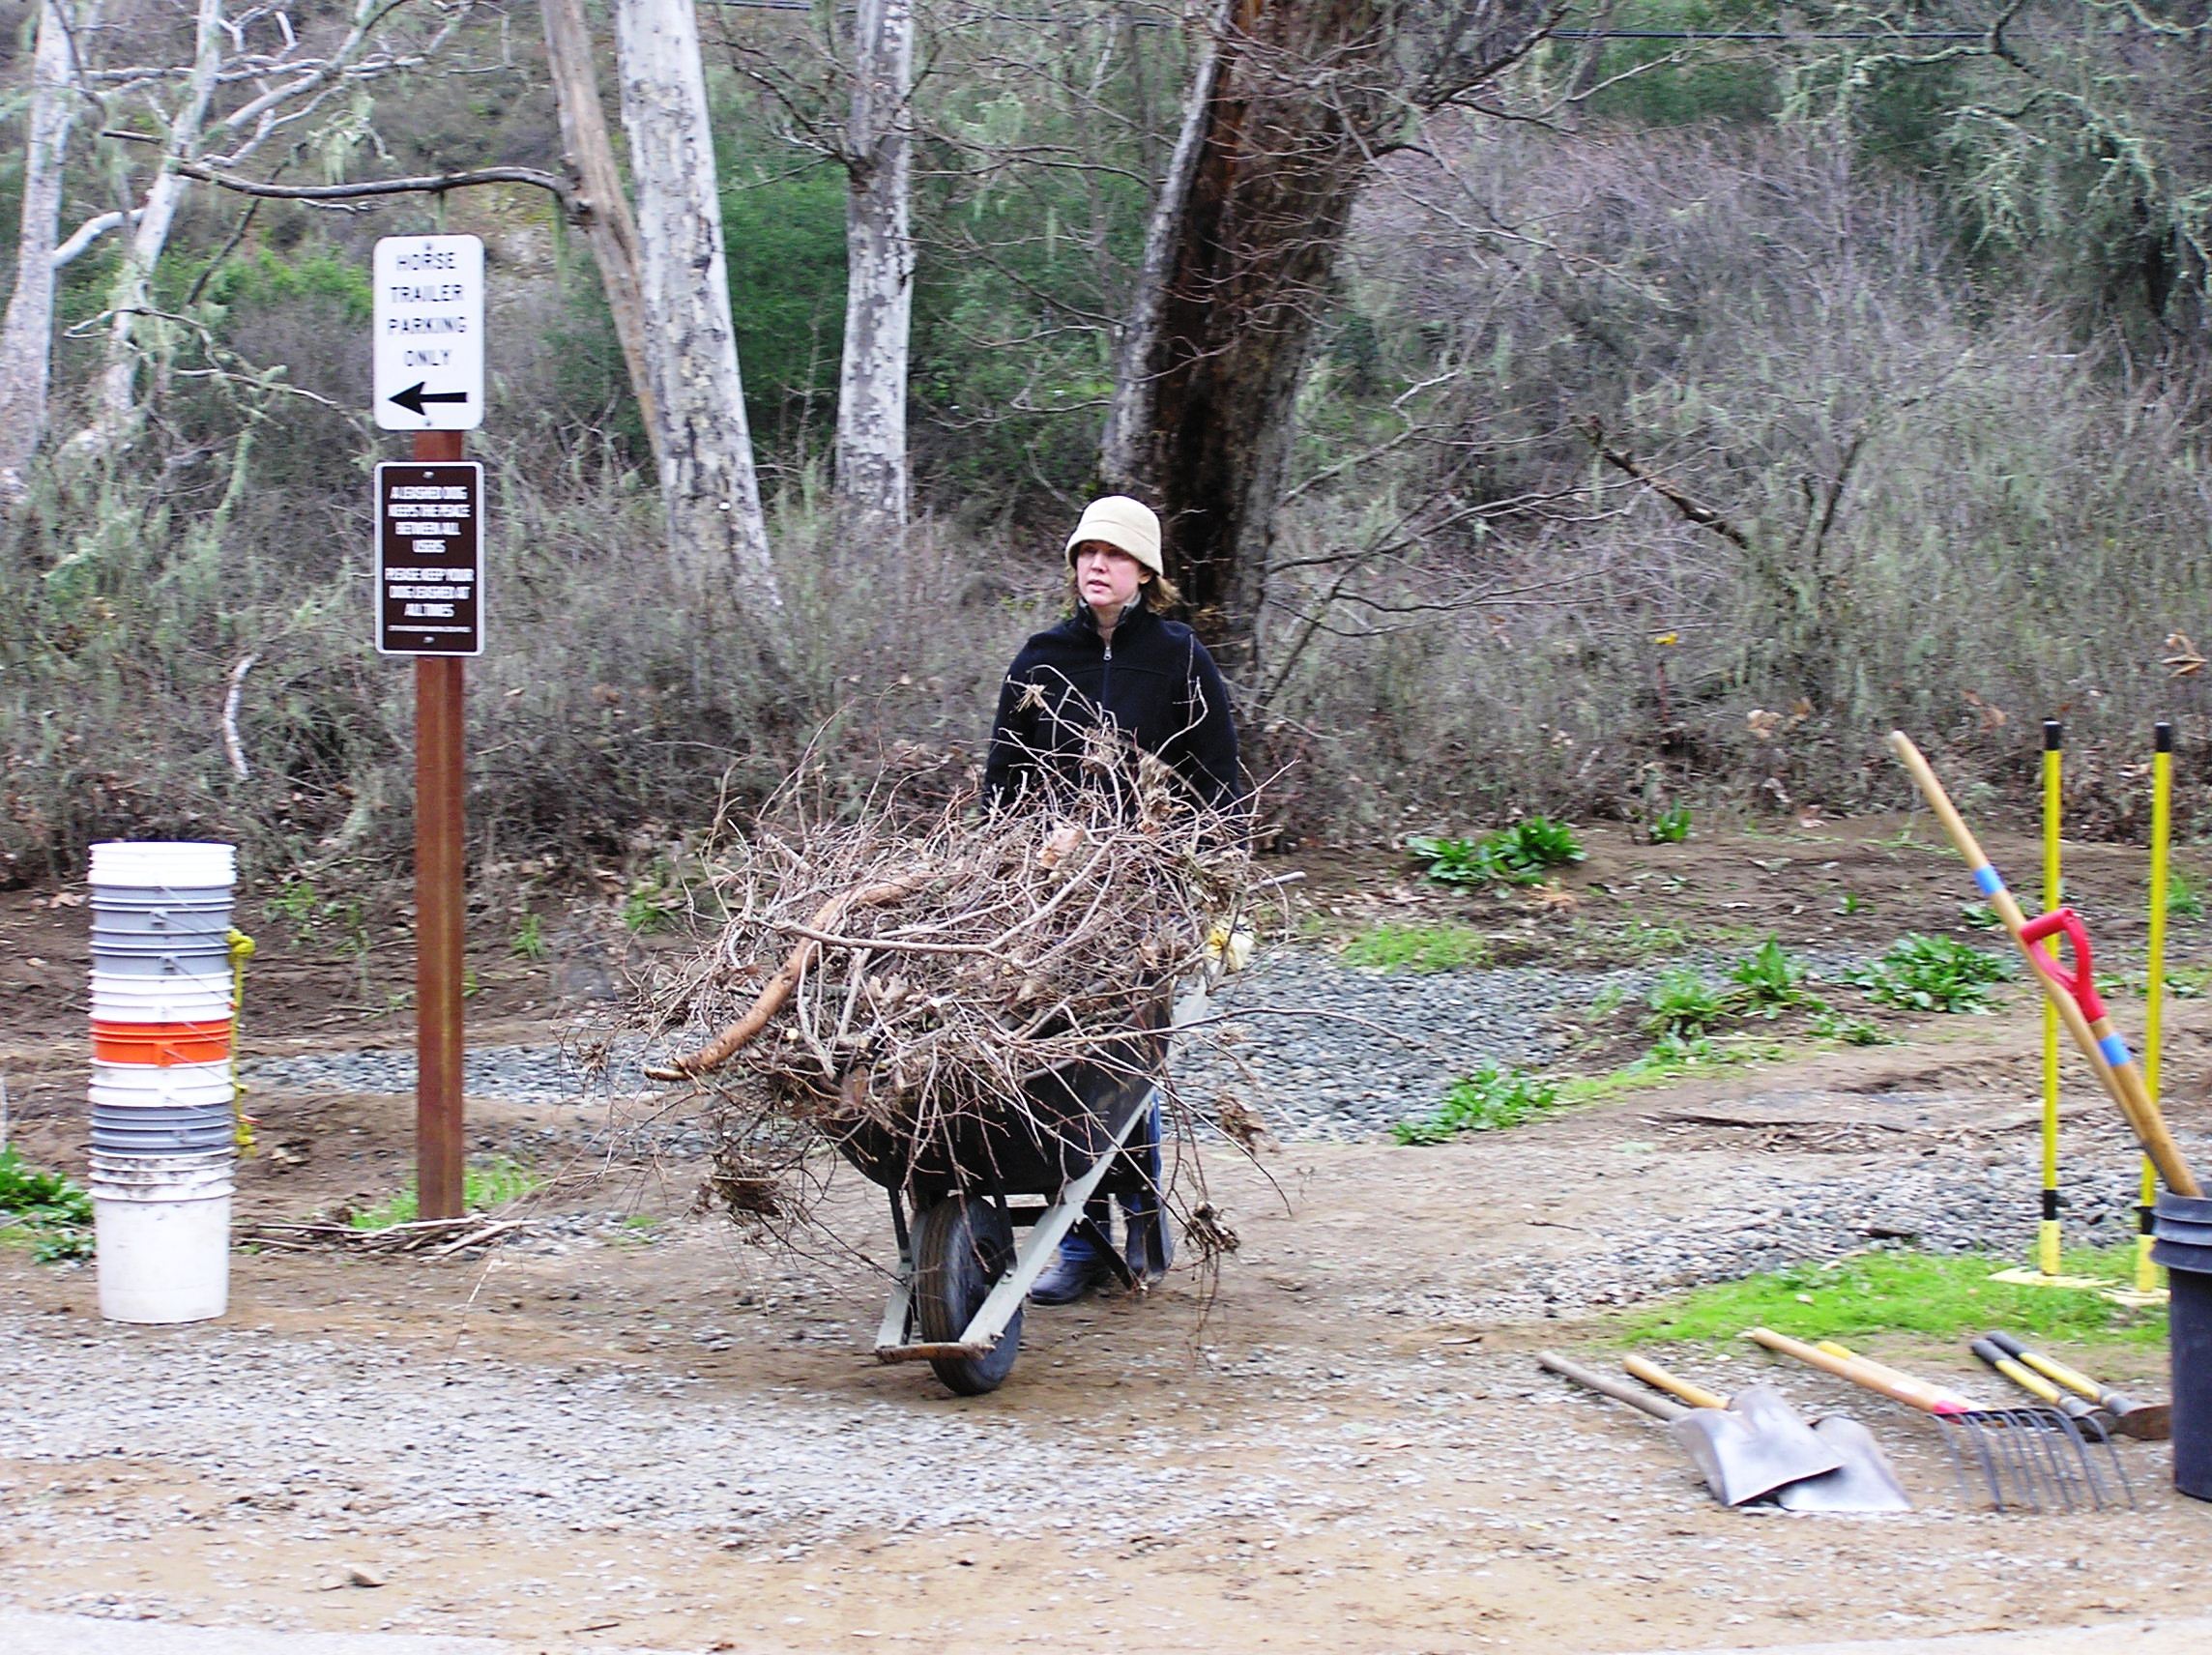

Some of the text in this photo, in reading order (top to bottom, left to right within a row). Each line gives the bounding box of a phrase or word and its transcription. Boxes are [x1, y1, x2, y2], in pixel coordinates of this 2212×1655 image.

[396, 251, 456, 272] HORSE
[390, 284, 464, 304] TRAILER
[387, 316, 467, 335] PARKING
[403, 349, 453, 367] ONLY
